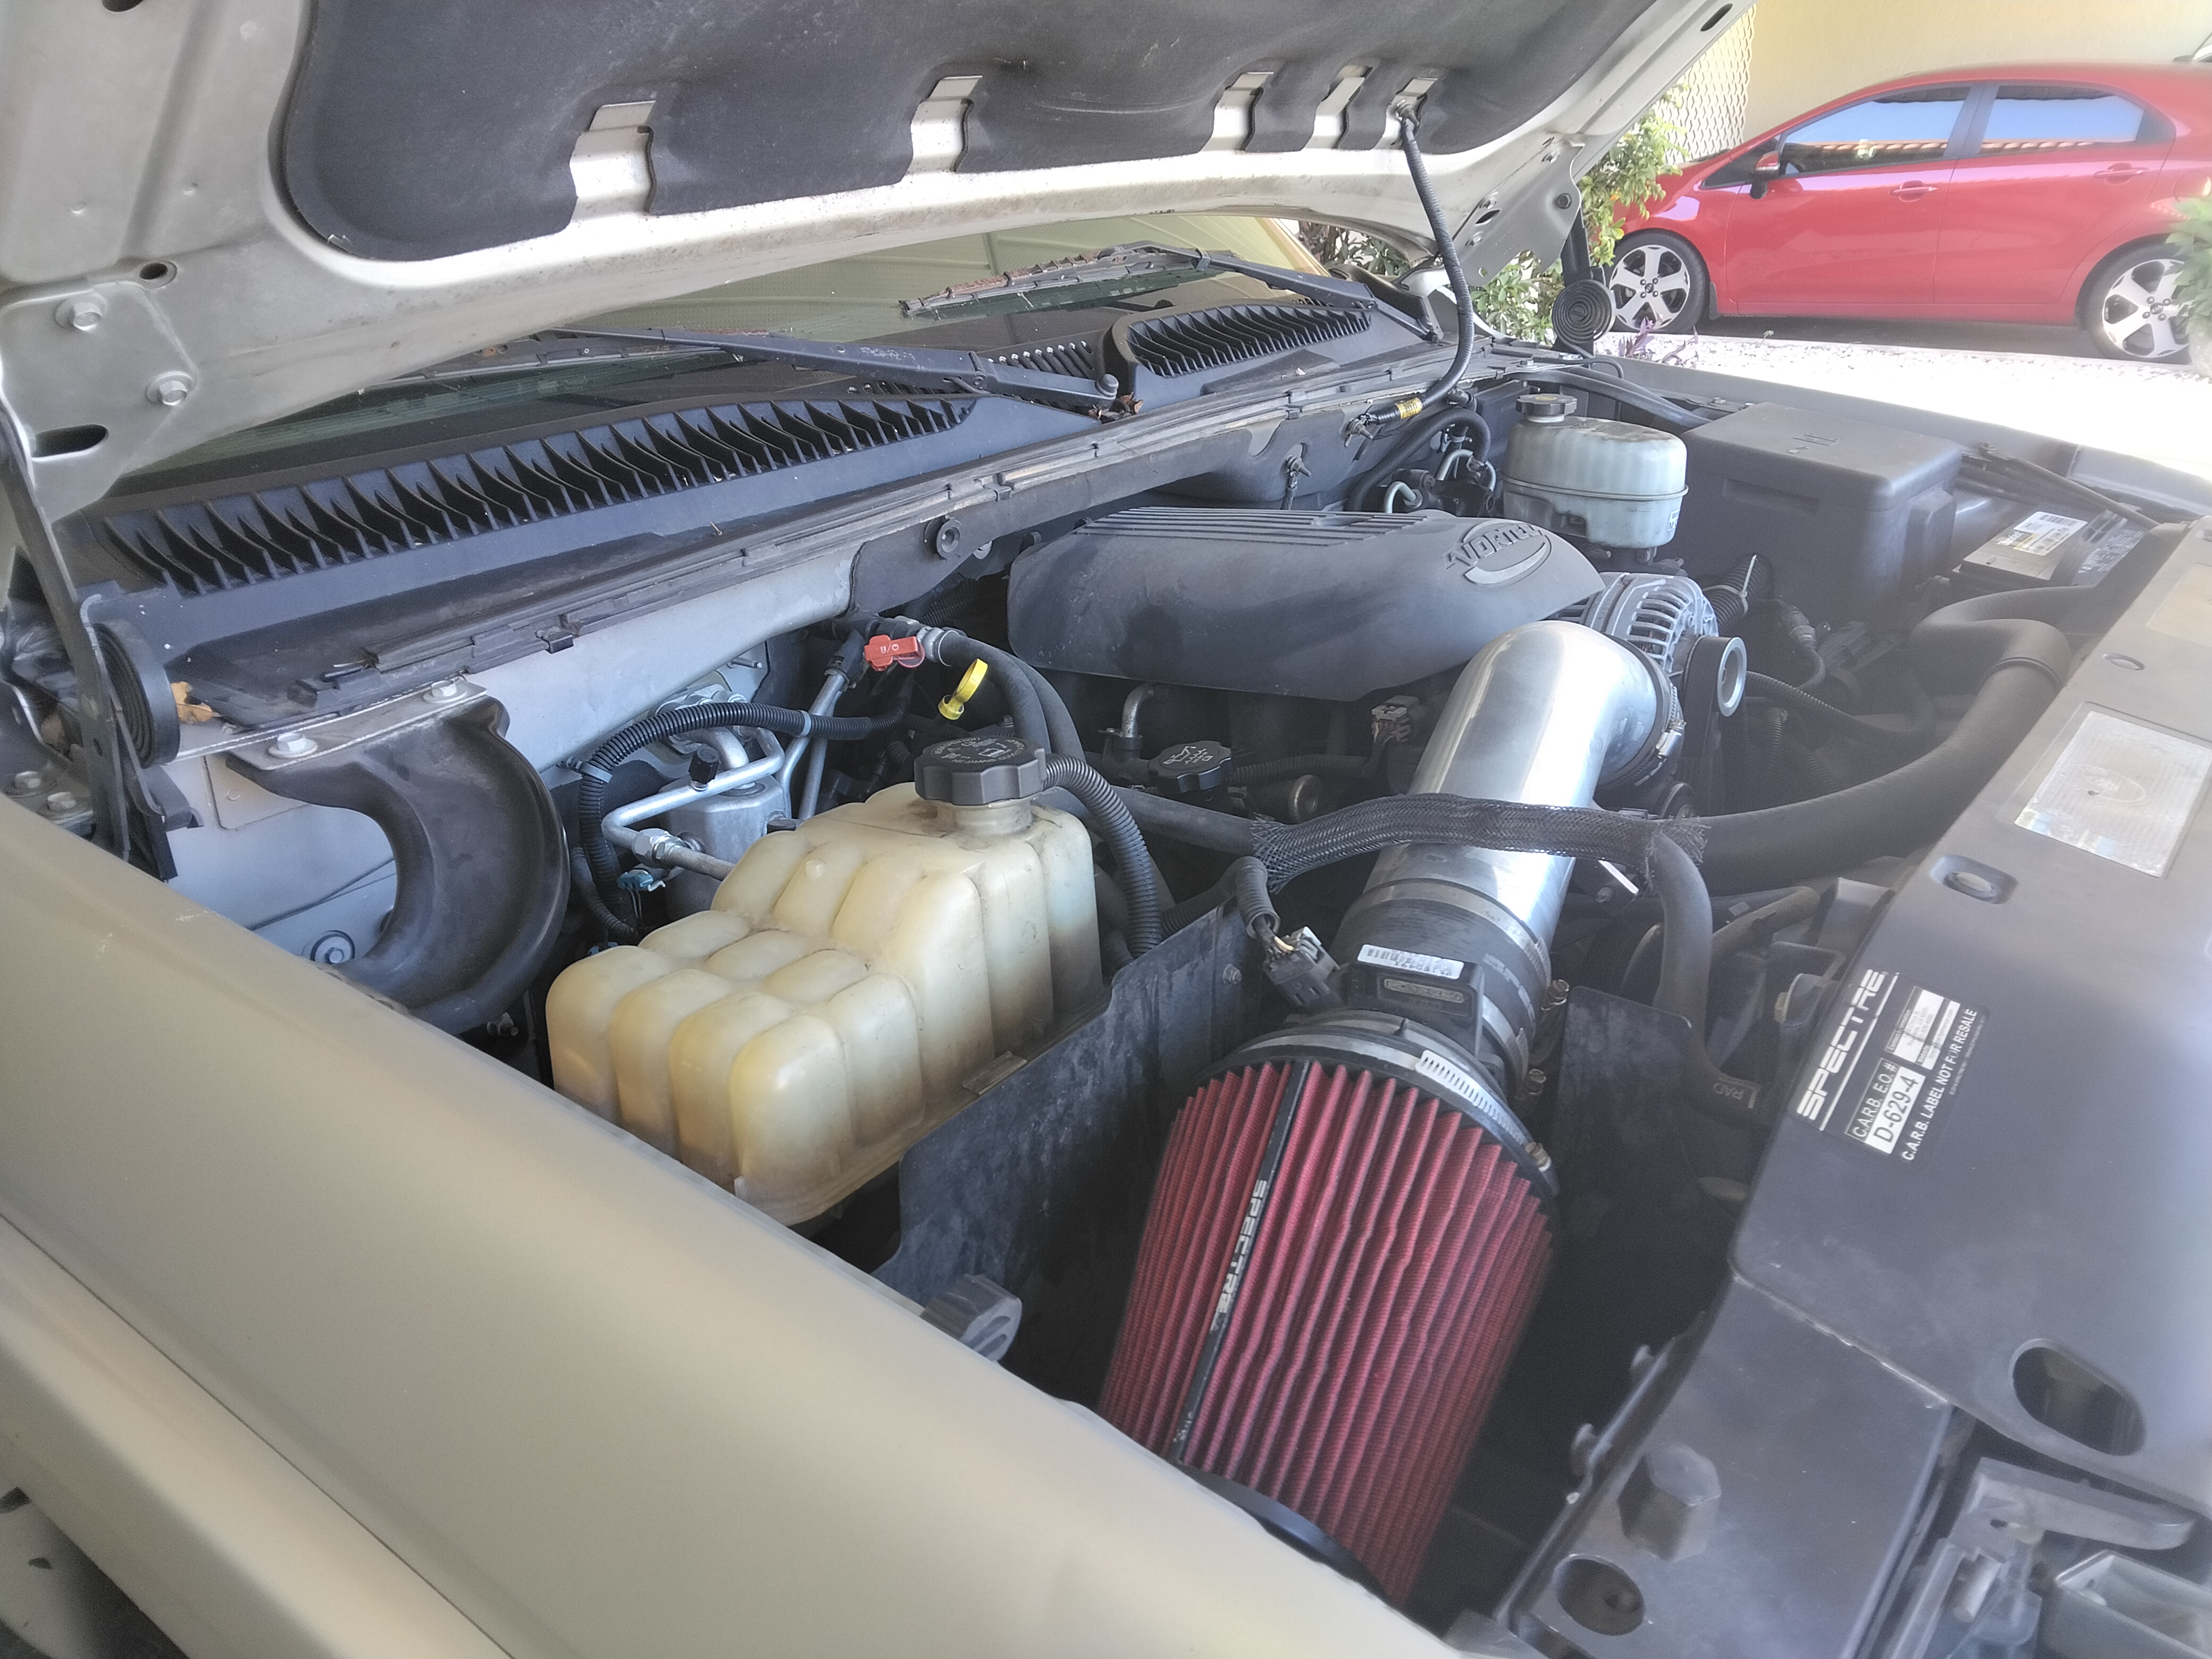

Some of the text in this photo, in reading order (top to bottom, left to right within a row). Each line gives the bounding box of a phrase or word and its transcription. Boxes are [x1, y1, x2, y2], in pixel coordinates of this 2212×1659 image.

[1797, 969, 1886, 1120] SPECTRE
[1953, 1009, 1978, 1044] RESALE
[1936, 1063, 1954, 1085] NOT
[1945, 1043, 1963, 1064] FOR
[1852, 1096, 1881, 1138] C.A.R.B.
[1873, 1073, 1894, 1093] E.O.
[1874, 1075, 1920, 1143] D-629-4
[1920, 1086, 1945, 1119] LABEL
[1901, 1119, 1930, 1160] C.A.R.B.
[1216, 1179, 1267, 1313] SPECTRE
